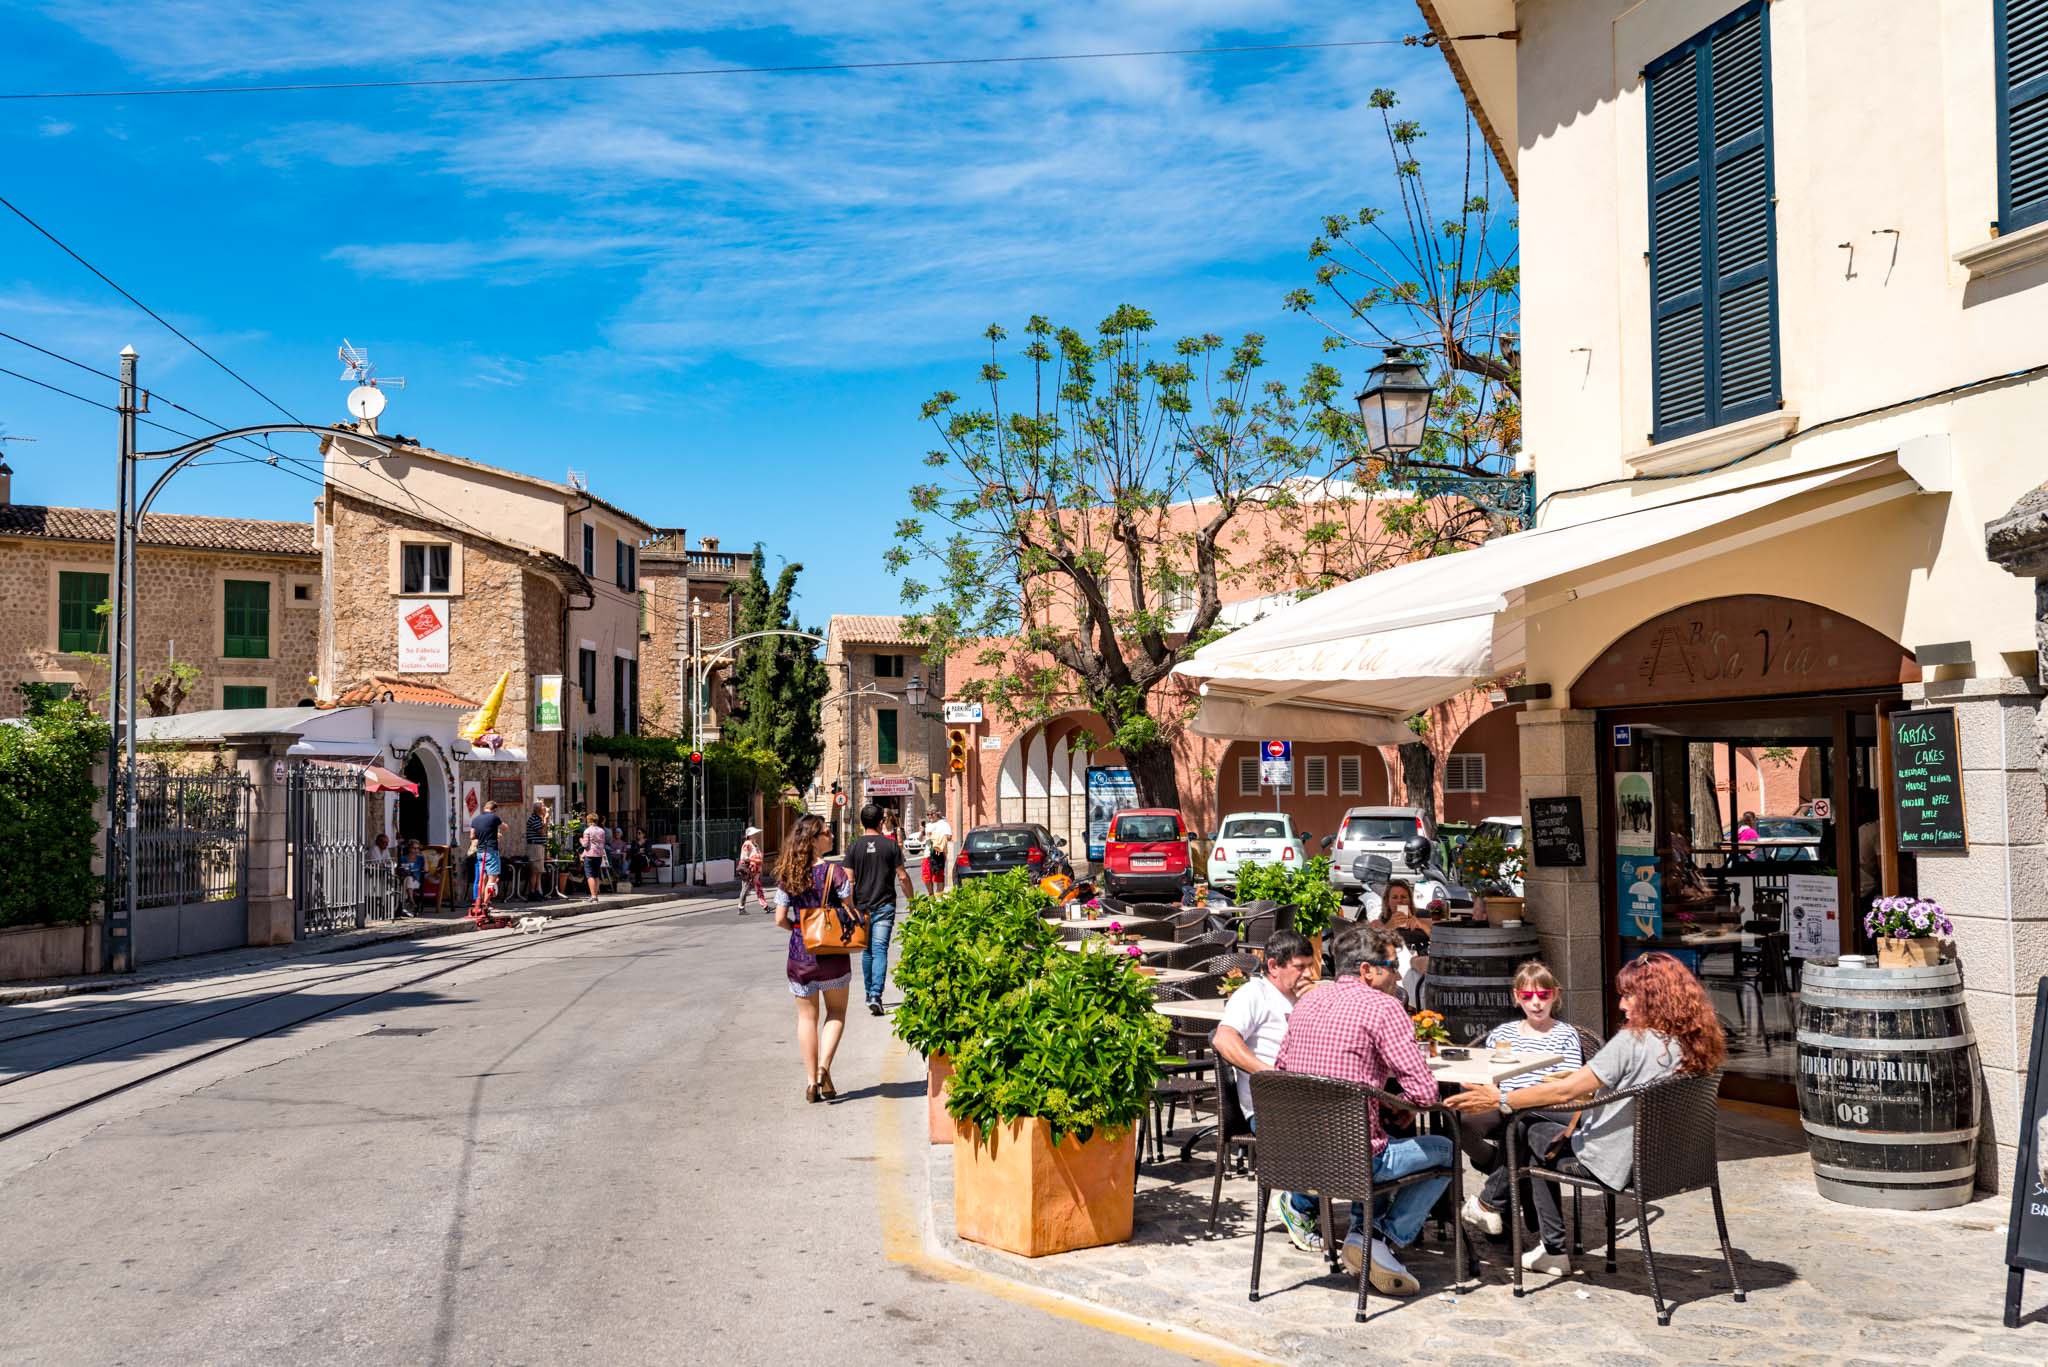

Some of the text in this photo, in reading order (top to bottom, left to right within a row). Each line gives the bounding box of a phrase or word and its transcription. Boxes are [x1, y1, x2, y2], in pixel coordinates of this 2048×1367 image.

[1898, 723, 1936, 744] TARTAS
[1915, 749, 1946, 765] CAKES
[1851, 1059, 1930, 1082] PATERNINA
[1837, 1102, 1870, 1124] 08
